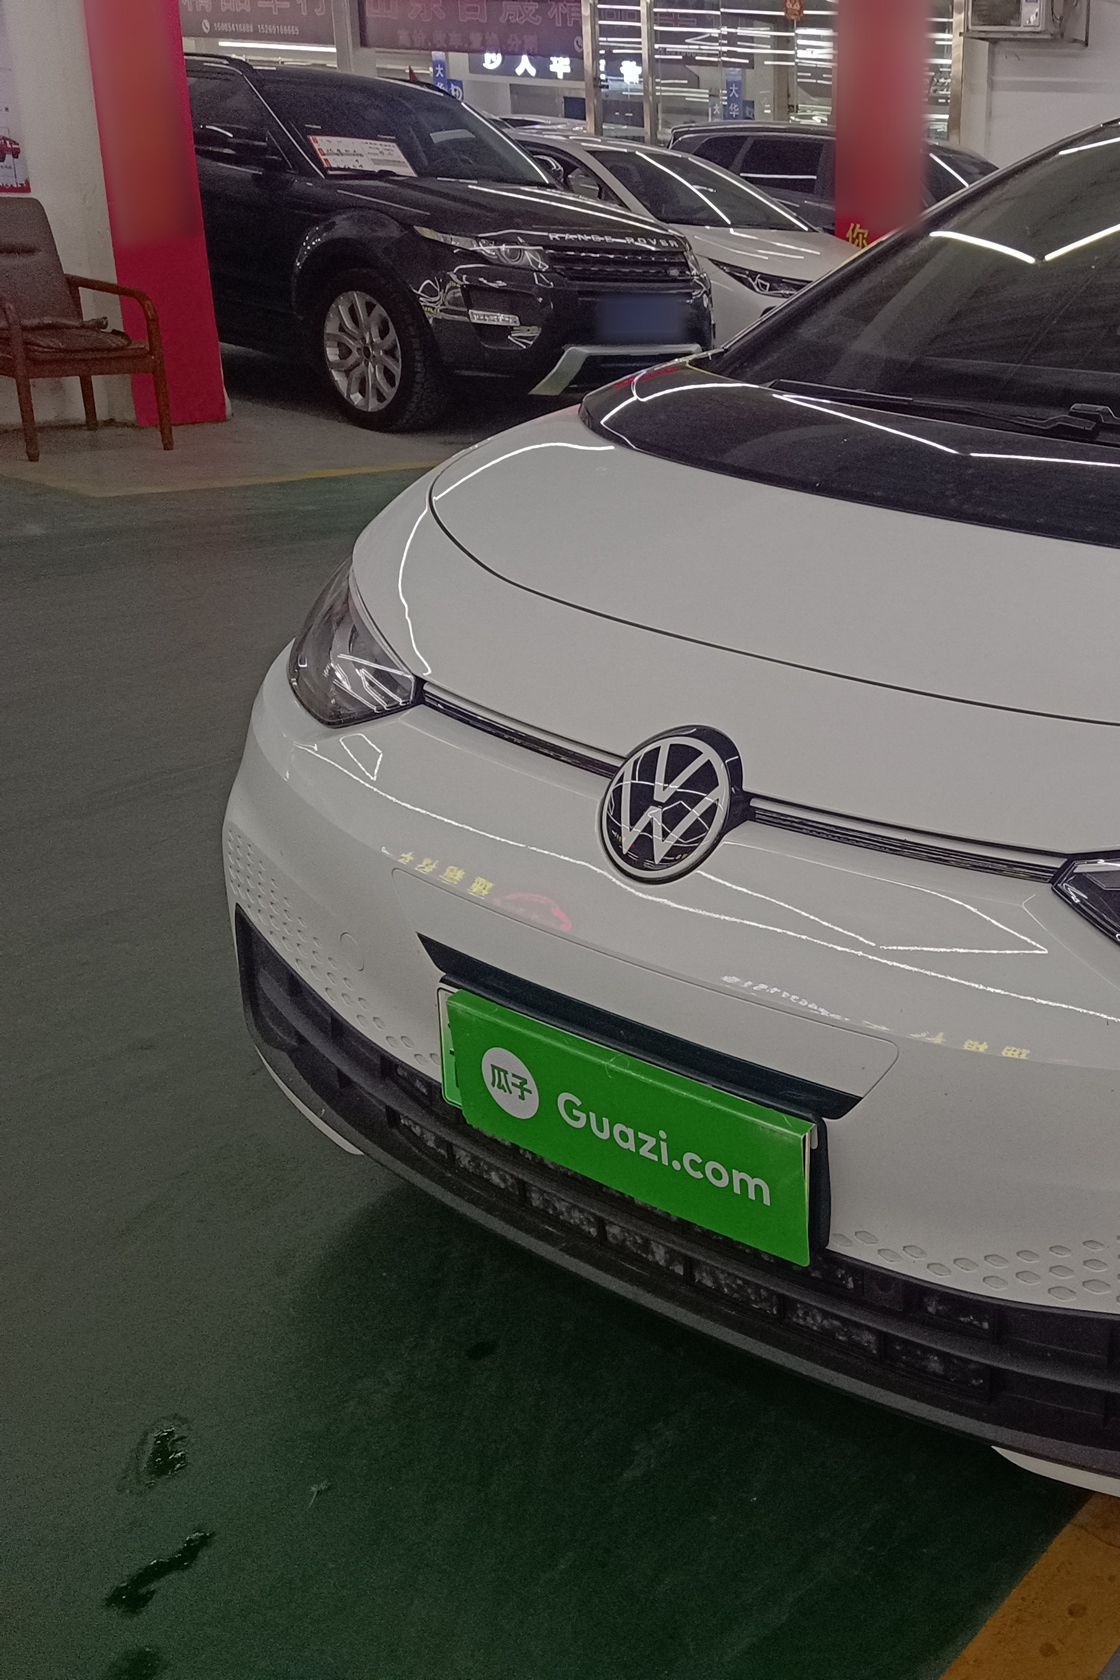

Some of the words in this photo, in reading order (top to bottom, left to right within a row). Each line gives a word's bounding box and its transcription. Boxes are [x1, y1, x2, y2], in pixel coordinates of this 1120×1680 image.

[549, 232, 614, 243] RANGE
[625, 236, 679, 248] ROVER
[490, 1063, 533, 1101] 瓜子
[557, 1092, 771, 1206] Guazi.com
